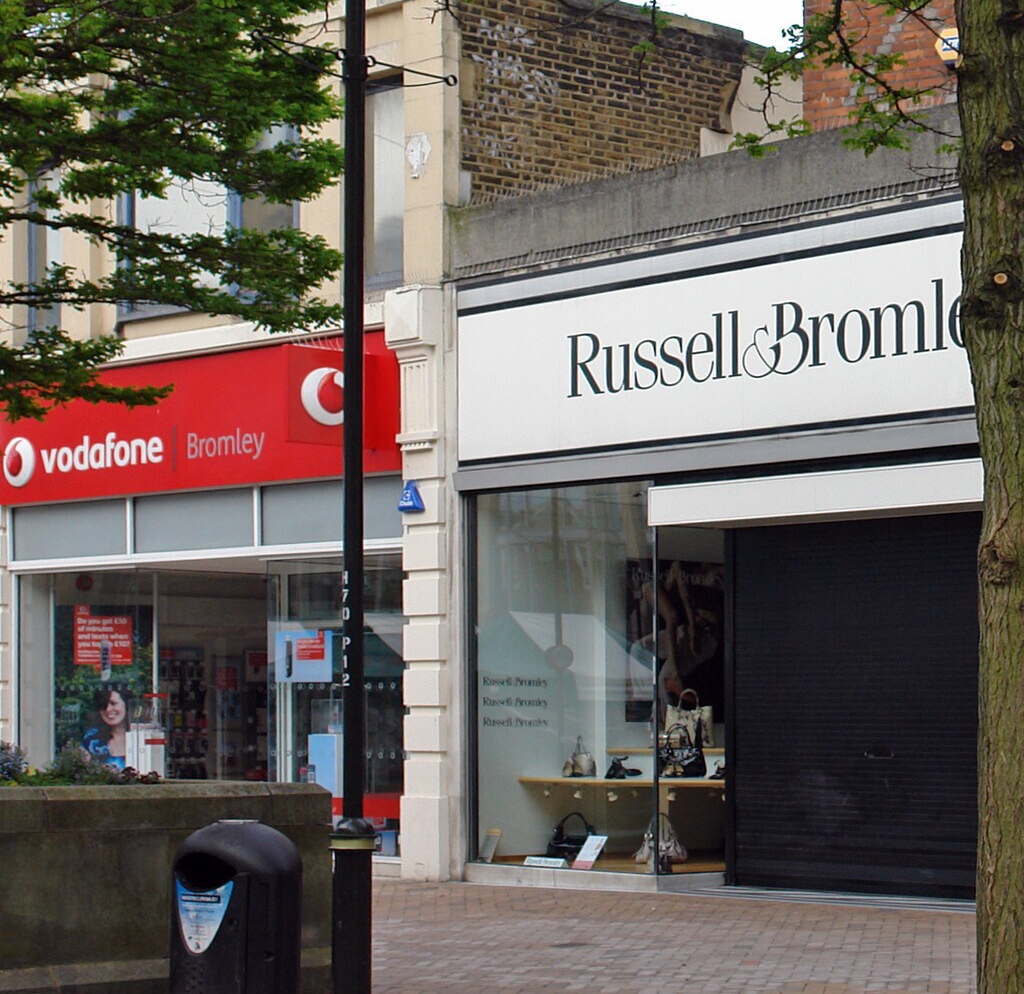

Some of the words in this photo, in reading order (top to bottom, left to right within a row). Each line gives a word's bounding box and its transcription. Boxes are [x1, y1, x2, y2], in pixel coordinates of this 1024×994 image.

[567, 310, 742, 398] Russell
[771, 278, 967, 375] Bromle
[41, 432, 164, 473] vodafone
[187, 428, 265, 459] Bromley
